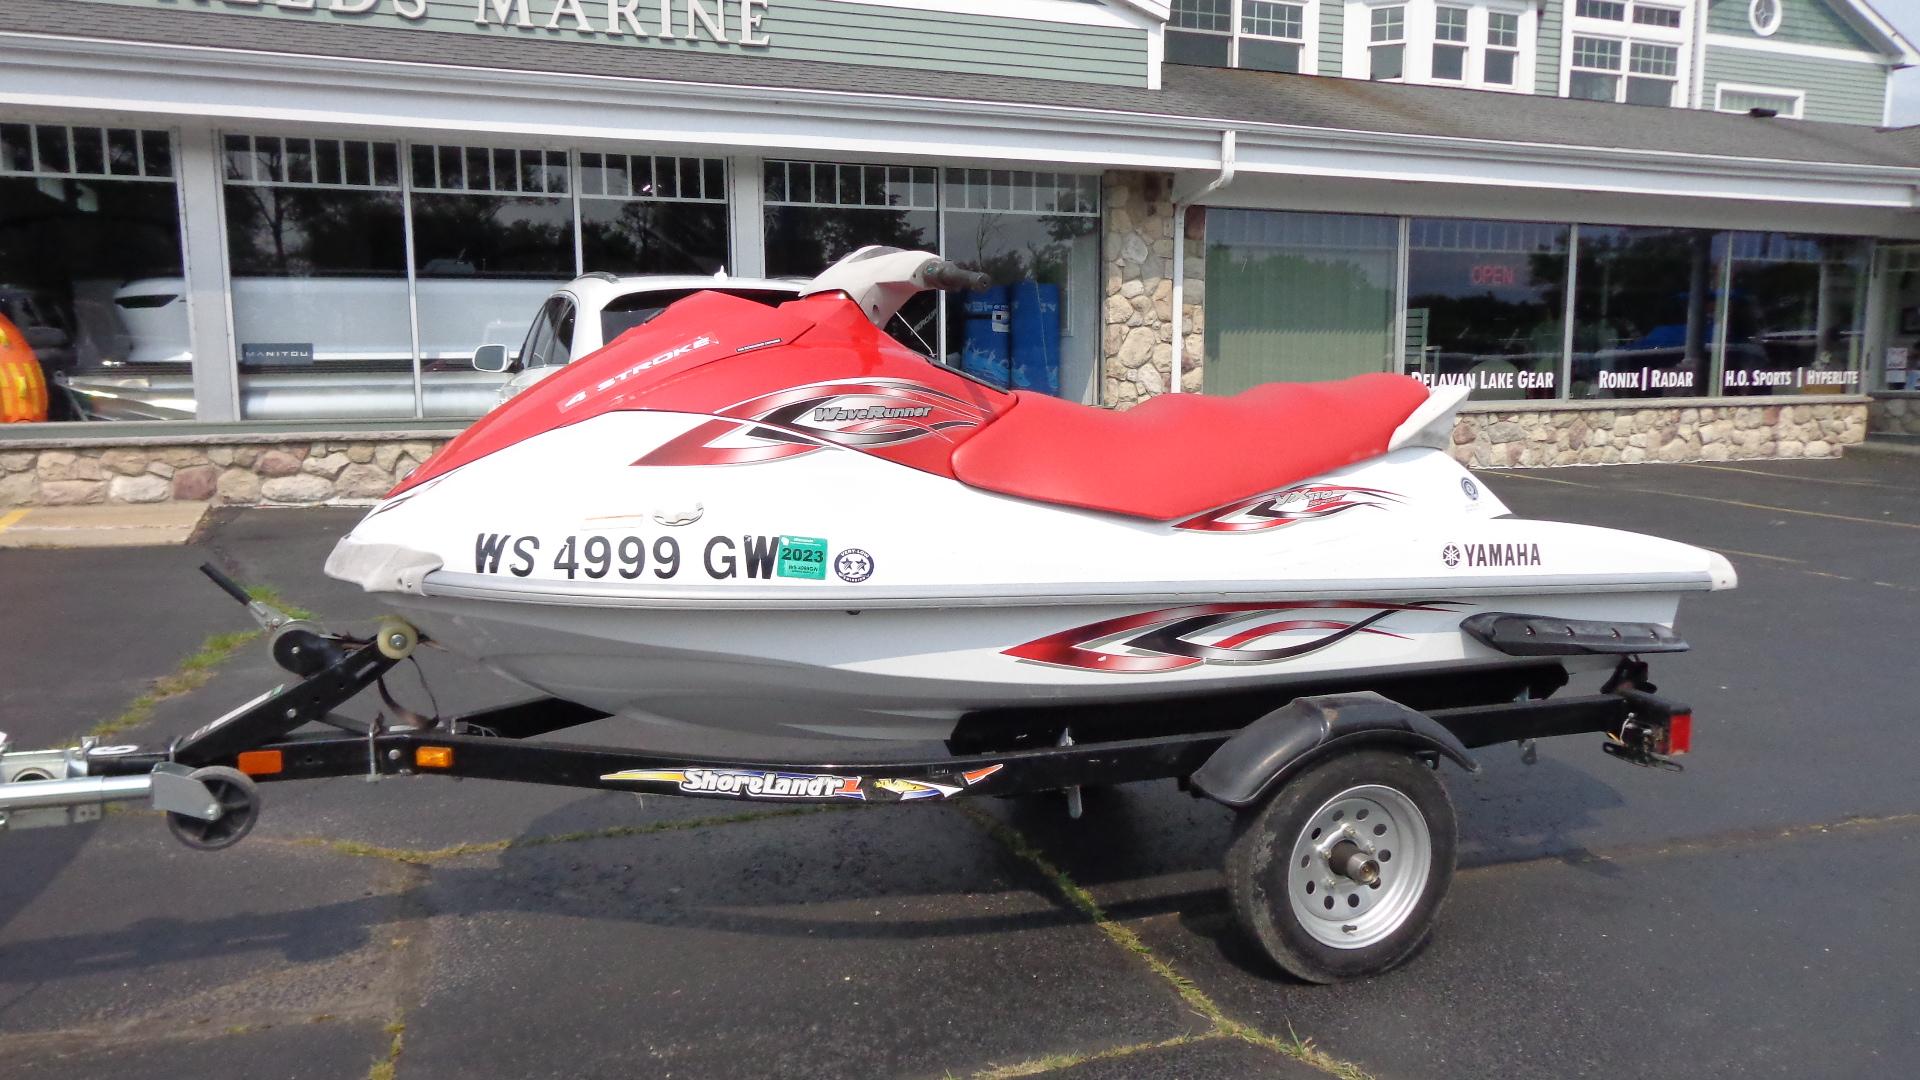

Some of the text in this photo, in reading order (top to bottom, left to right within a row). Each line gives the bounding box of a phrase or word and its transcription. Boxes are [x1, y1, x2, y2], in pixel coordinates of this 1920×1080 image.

[1472, 265, 1513, 284] OPEN
[1480, 371, 1513, 389] LAKE
[1517, 370, 1554, 388] GEAR
[1599, 370, 1693, 388] RONIX RADAR
[1725, 370, 1859, 386] H.O. SPORTS HYPERLITE
[814, 406, 932, 421] WaveRunner
[475, 533, 780, 580] WS 4999 GW
[781, 547, 824, 563] 2023
[1464, 544, 1541, 567] YAMAHA
